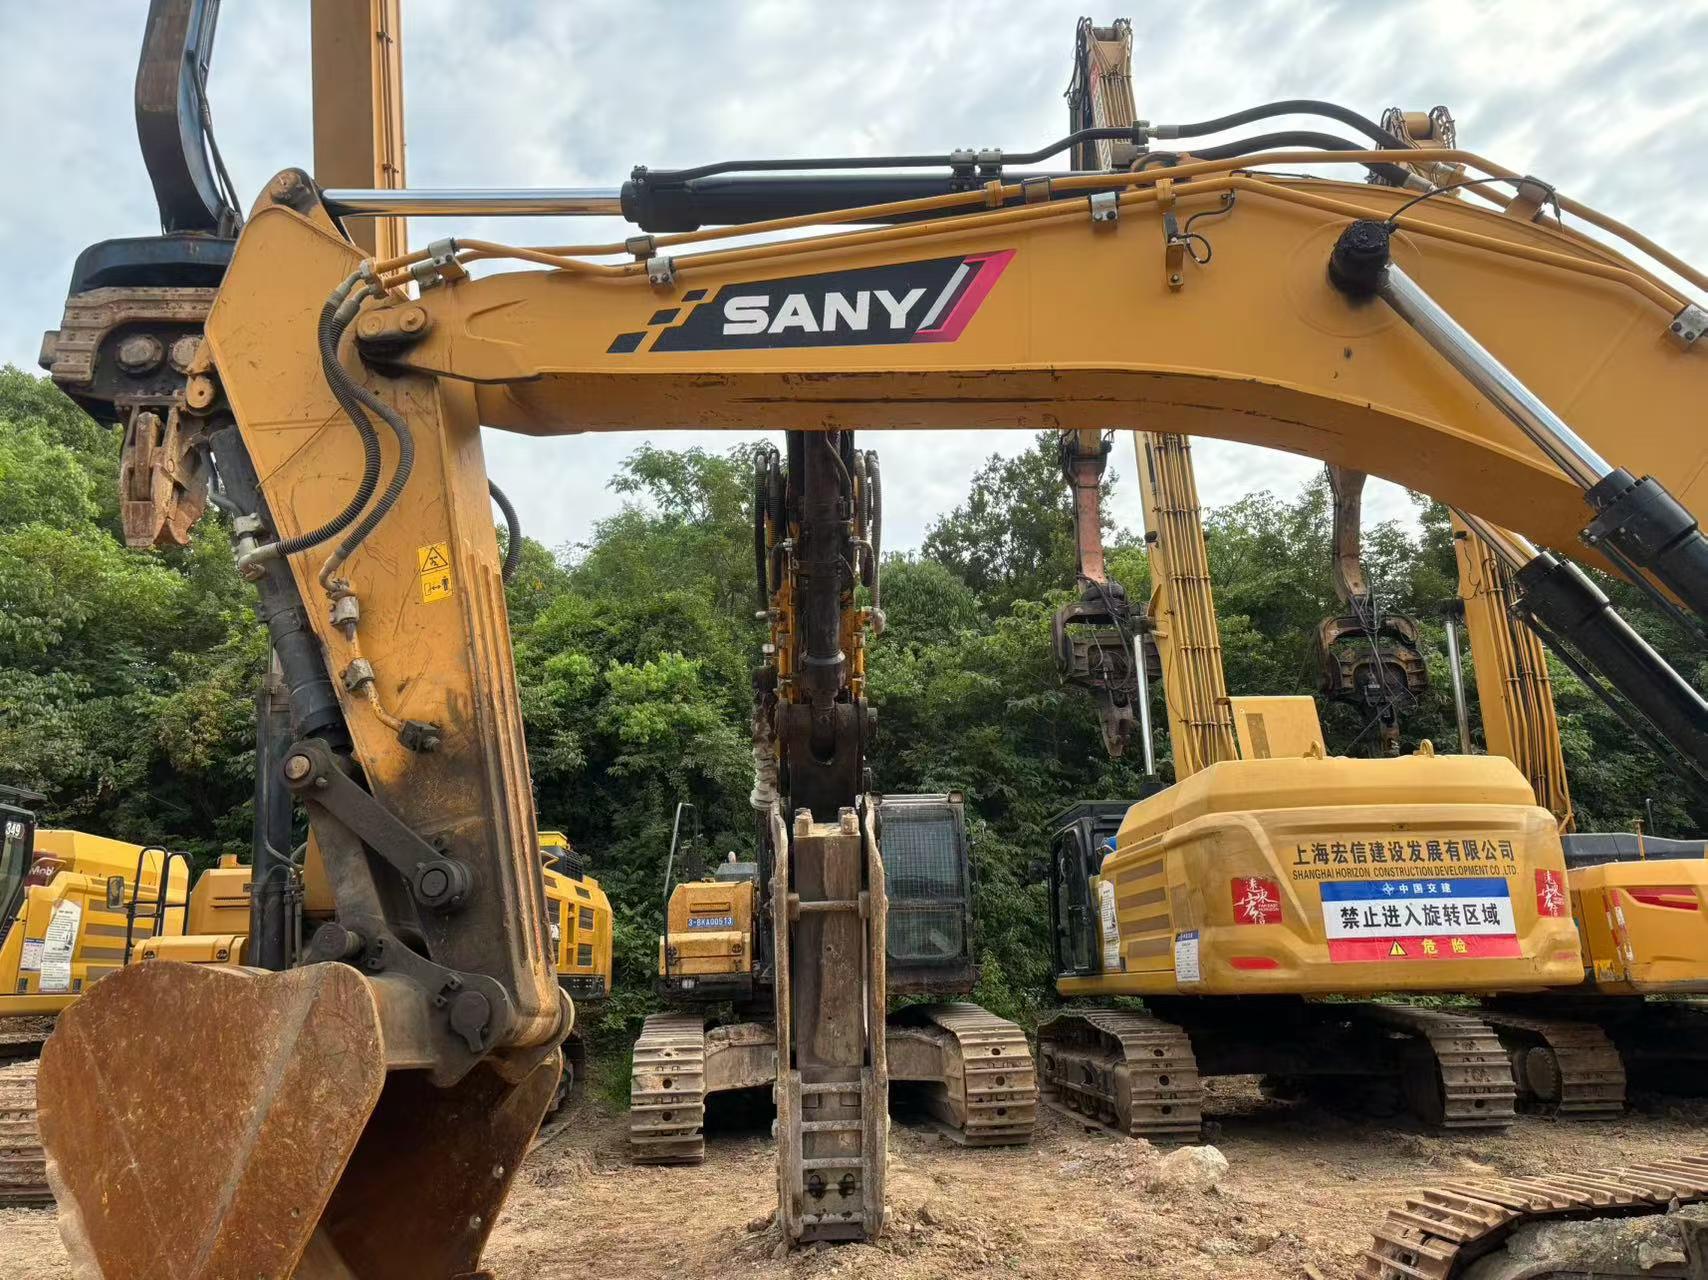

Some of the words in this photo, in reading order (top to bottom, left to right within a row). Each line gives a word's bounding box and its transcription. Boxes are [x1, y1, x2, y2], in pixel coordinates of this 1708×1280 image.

[723, 287, 928, 336] SANY
[5, 820, 22, 838] 349
[1292, 839, 1516, 866] 上海宏信建设发展有限公司
[1292, 867, 1335, 880] SHANGHAI
[1336, 866, 1371, 878] HORIZON
[1373, 865, 1434, 878] CONSTRUCTION
[1435, 865, 1488, 877] DEVELOPMENT
[1399, 883, 1452, 895] 中国交建
[1340, 902, 1501, 930] 禁止进入旋转区域
[1421, 938, 1468, 955] 危险
